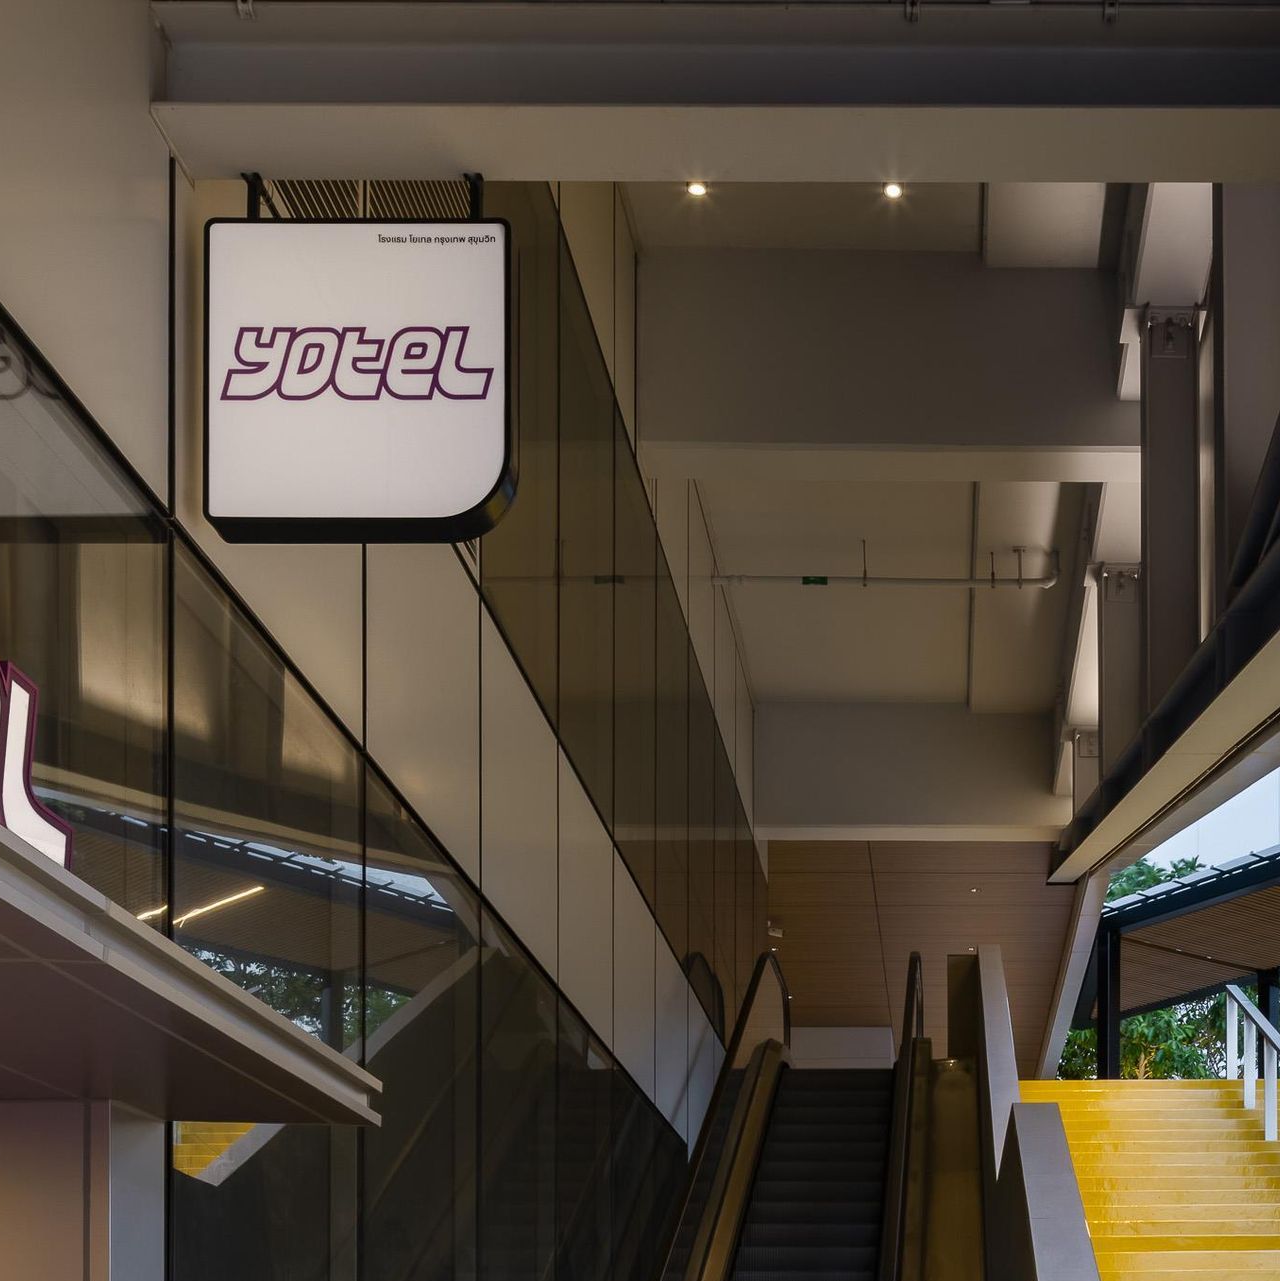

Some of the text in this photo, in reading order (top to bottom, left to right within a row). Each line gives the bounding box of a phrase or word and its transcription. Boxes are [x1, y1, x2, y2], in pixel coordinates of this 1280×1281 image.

[378, 234, 407, 244] โรงแรม
[434, 235, 465, 246] กรุงเทพ
[467, 234, 496, 246] สุขุมวิท
